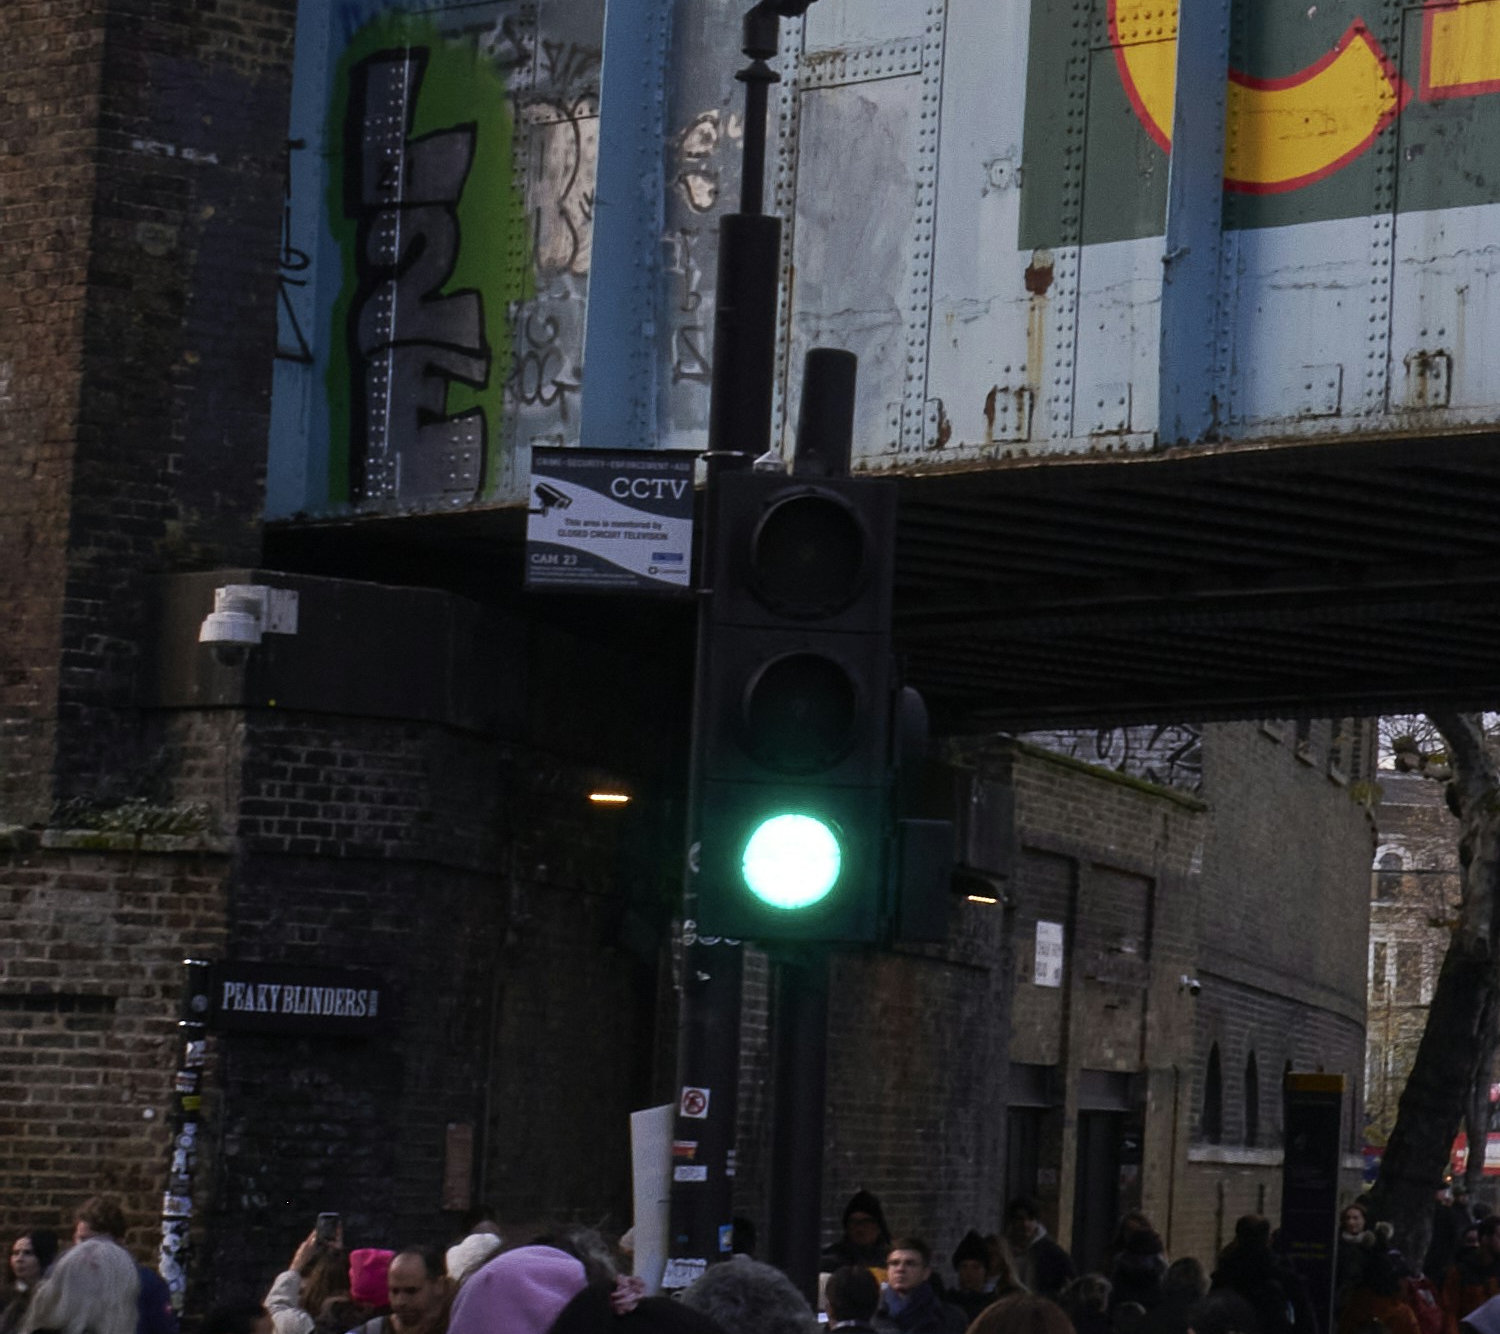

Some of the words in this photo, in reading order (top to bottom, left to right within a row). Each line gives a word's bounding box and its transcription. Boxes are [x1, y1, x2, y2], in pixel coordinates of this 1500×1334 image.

[611, 477, 689, 500] CCTV
[531, 553, 558, 564] CAM
[563, 554, 578, 565] 23
[221, 981, 281, 1013] PEAKY
[281, 985, 369, 1017] BLINDERS
